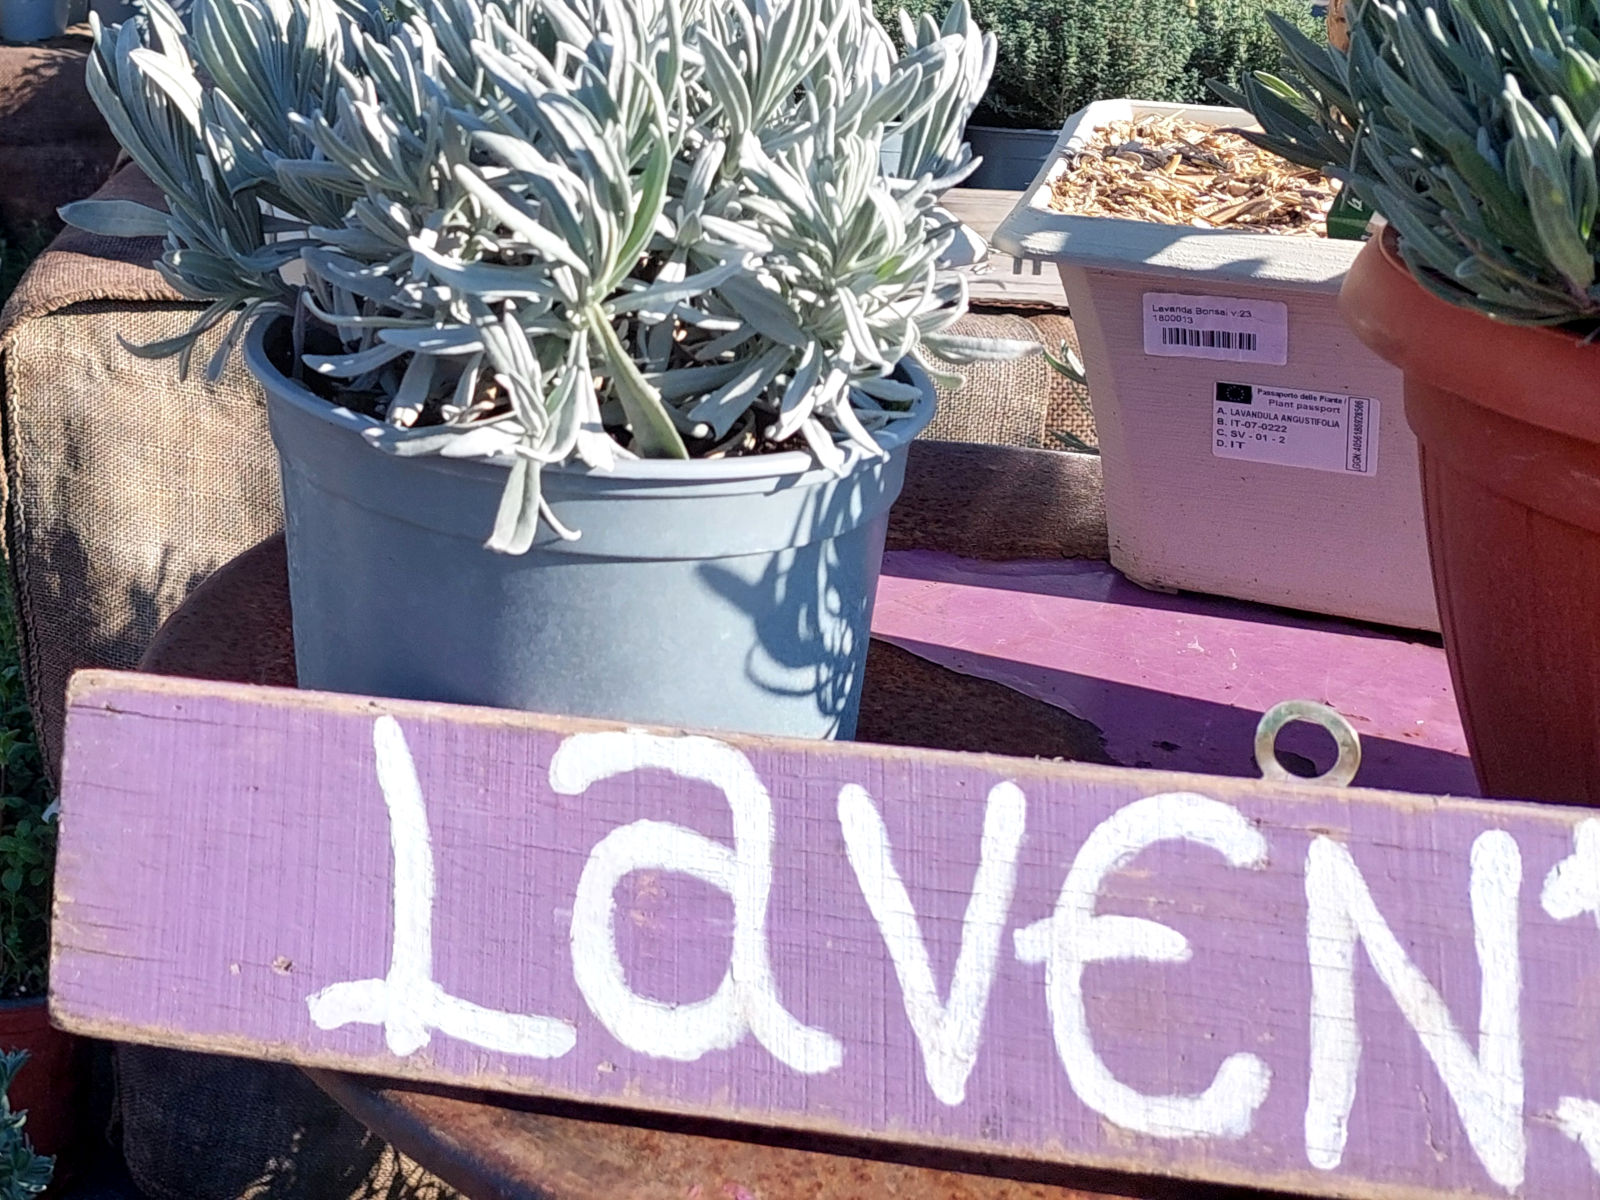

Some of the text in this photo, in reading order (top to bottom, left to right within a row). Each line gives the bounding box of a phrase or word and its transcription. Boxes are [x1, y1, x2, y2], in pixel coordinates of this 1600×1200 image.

[1152, 304, 1193, 315] Lavanda
[1195, 307, 1229, 317] Bonsai
[1153, 314, 1194, 324] 1800013
[1257, 388, 1299, 401] Passaporto
[1300, 392, 1318, 401] delle
[1319, 395, 1343, 405] Piante
[1268, 399, 1341, 414] Plant passport
[1217, 406, 1340, 429] A. LAVANDULA ANGUSTIFOLIA
[1217, 417, 1288, 433] B. IT-07-0222
[1216, 428, 1228, 437] C.
[1230, 430, 1246, 439] SV
[1255, 432, 1268, 442] 01
[1279, 435, 1287, 444] 2
[1216, 439, 1246, 449] D. IT
